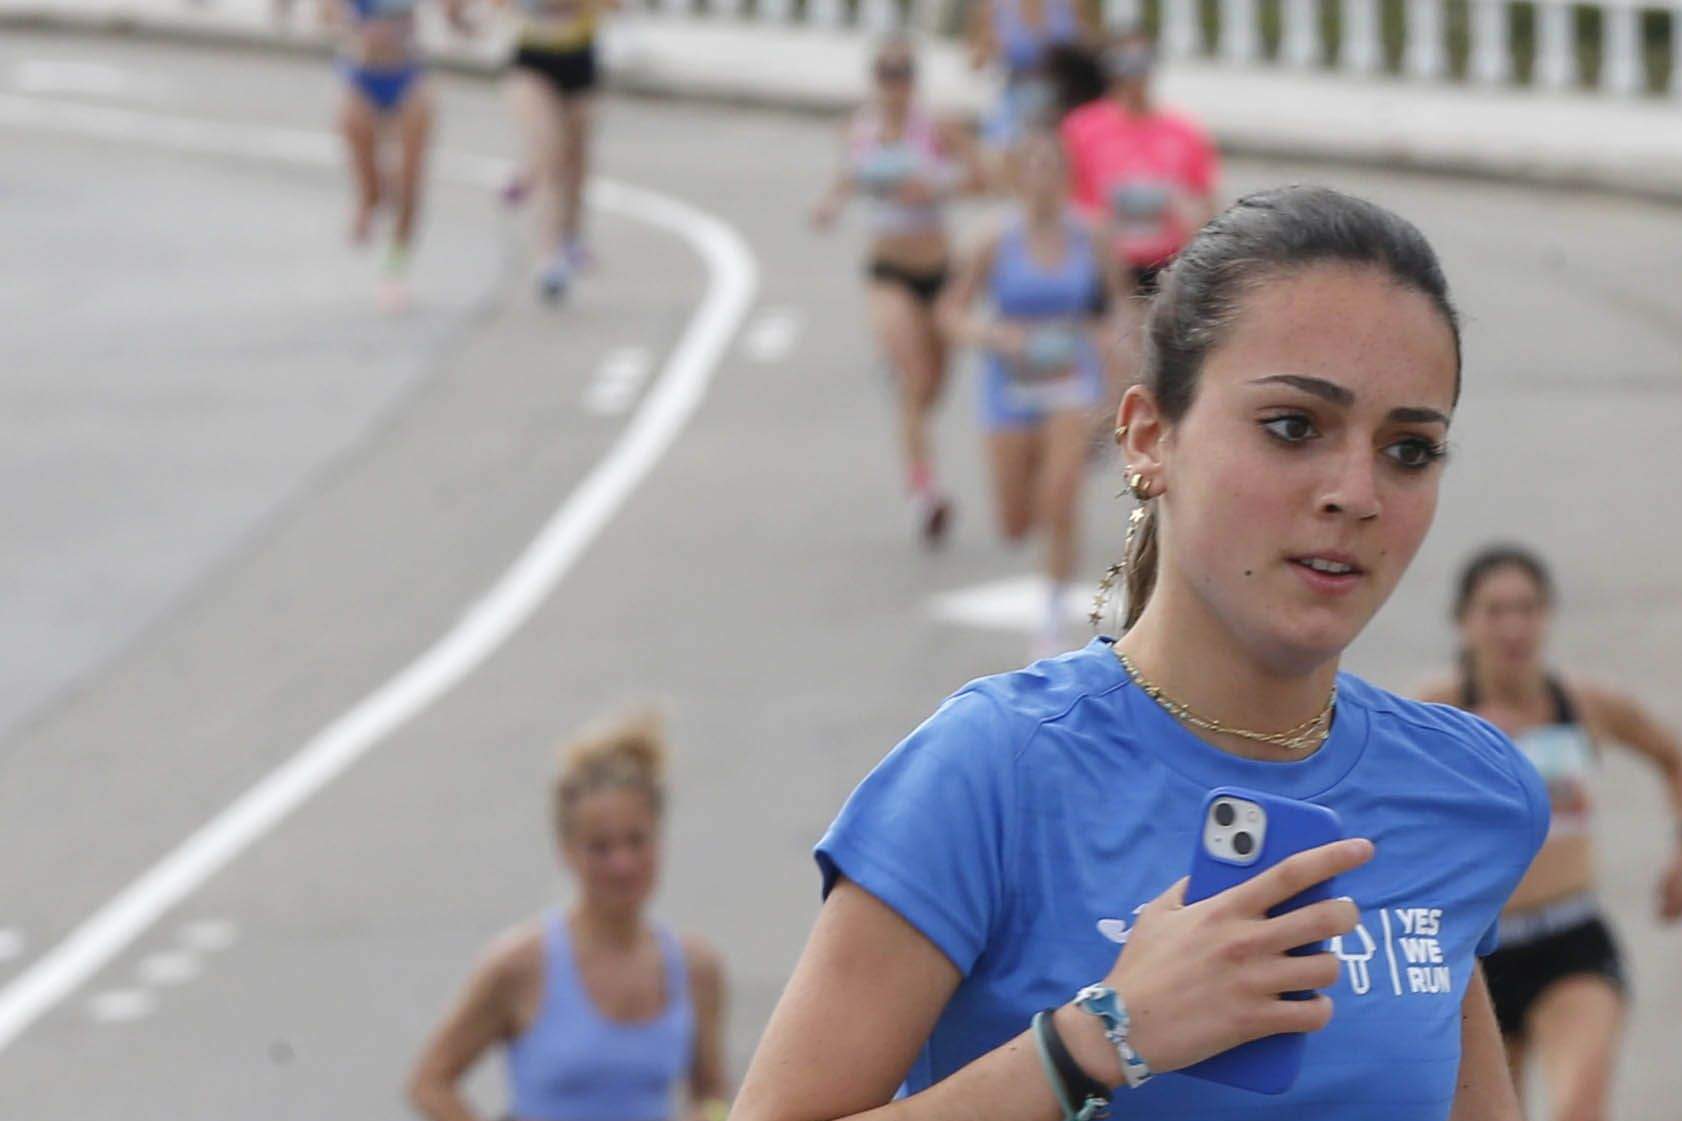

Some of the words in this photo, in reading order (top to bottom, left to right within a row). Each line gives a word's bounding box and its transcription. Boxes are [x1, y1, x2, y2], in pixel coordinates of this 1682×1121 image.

[1395, 908, 1443, 936] YES
[1399, 937, 1444, 963] WE
[1407, 966, 1451, 994] RUN
